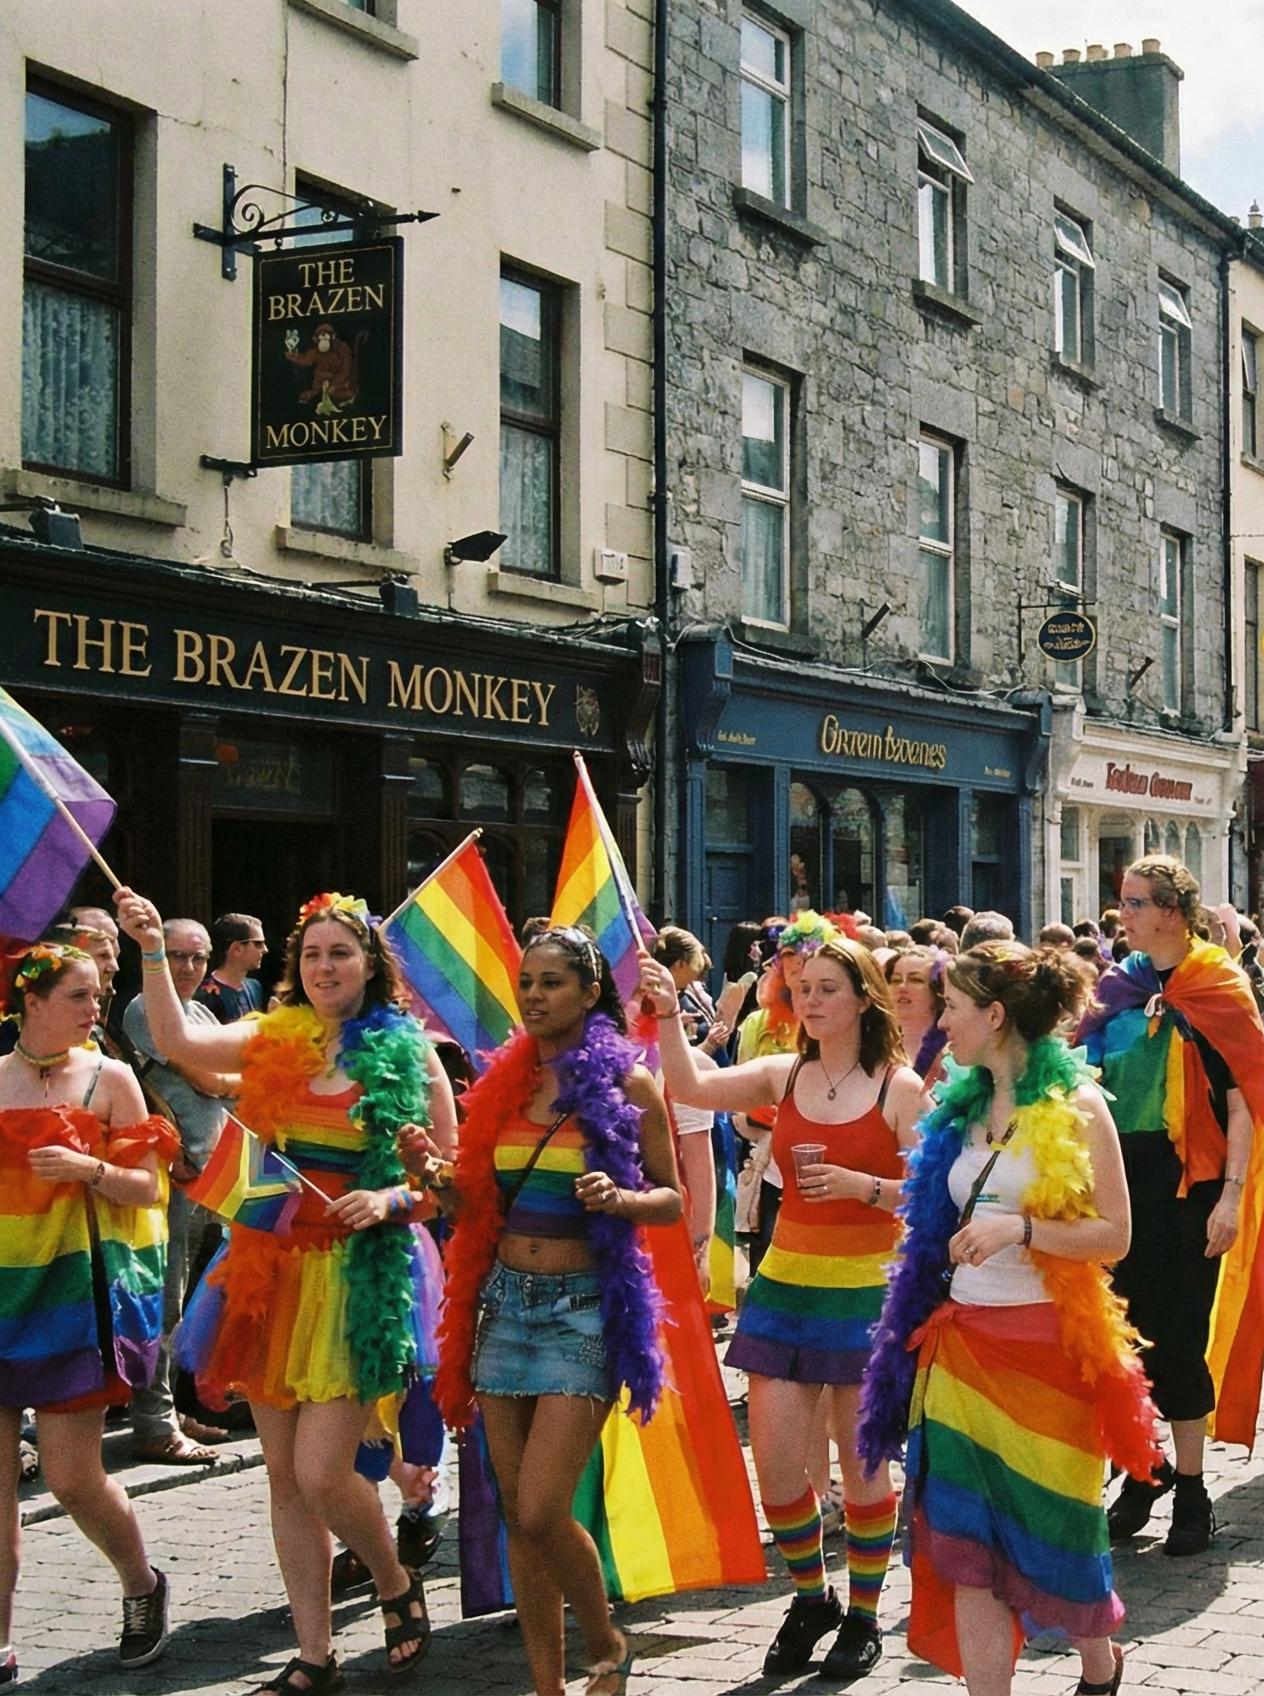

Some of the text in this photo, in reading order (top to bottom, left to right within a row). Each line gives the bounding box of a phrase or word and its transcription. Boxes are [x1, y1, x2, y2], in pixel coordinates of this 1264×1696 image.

[298, 258, 355, 288] THE
[267, 284, 385, 321] BRAZEN
[265, 415, 387, 449] MONKEY
[33, 608, 556, 726] THE BRAZEN MONKEY
